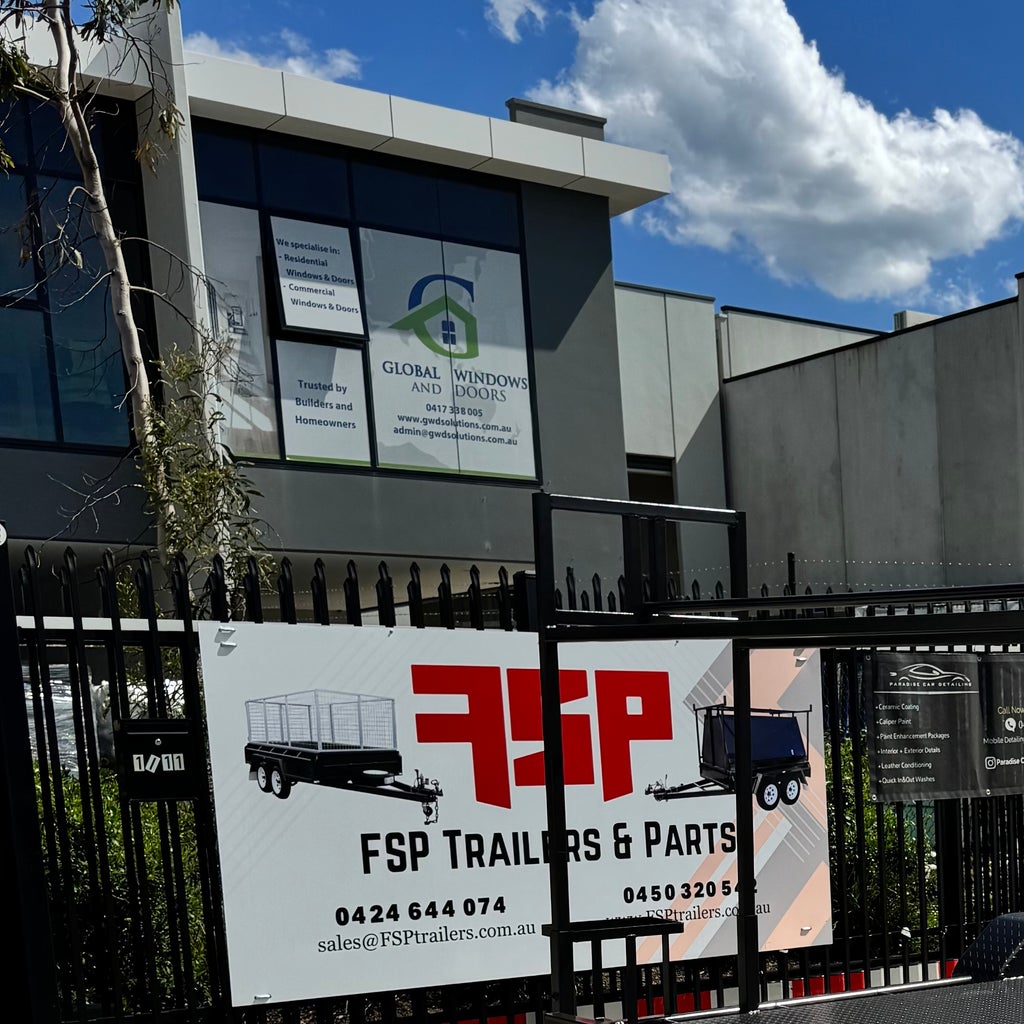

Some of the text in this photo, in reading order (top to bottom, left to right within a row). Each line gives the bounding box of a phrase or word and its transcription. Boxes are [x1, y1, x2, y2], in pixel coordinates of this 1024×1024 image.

[276, 238, 340, 255] We specialise in:
[284, 254, 328, 267] Residential
[286, 268, 354, 285] Windows & Doors
[288, 283, 335, 296] Commercial
[290, 298, 327, 309] Windows
[335, 304, 359, 314] Doors
[382, 360, 528, 390] GLOBAL WINDOWS
[298, 380, 347, 395] Trusted by
[411, 381, 507, 402] AND DOORS
[295, 397, 353, 411] Builders and
[426, 403, 483, 417] 0417 338 005
[295, 415, 356, 429] Homeowners
[397, 414, 512, 433] www.gwdsolutions.com.au
[393, 425, 518, 446] admin@gwdsolutions.com.au
[901, 703, 920, 711] Coating
[998, 706, 1010, 715] Call
[928, 732, 950, 740] Packages
[901, 761, 932, 769] Conditioning
[996, 757, 1020, 766] Paradise
[360, 830, 430, 874] FSP
[612, 822, 632, 860] &
[644, 821, 736, 858] PARTS
[623, 884, 676, 904] 0450
[681, 881, 716, 900] 320
[335, 896, 506, 926] 0424 644 074
[318, 923, 536, 952] sales@FSPtrailers.com.au
